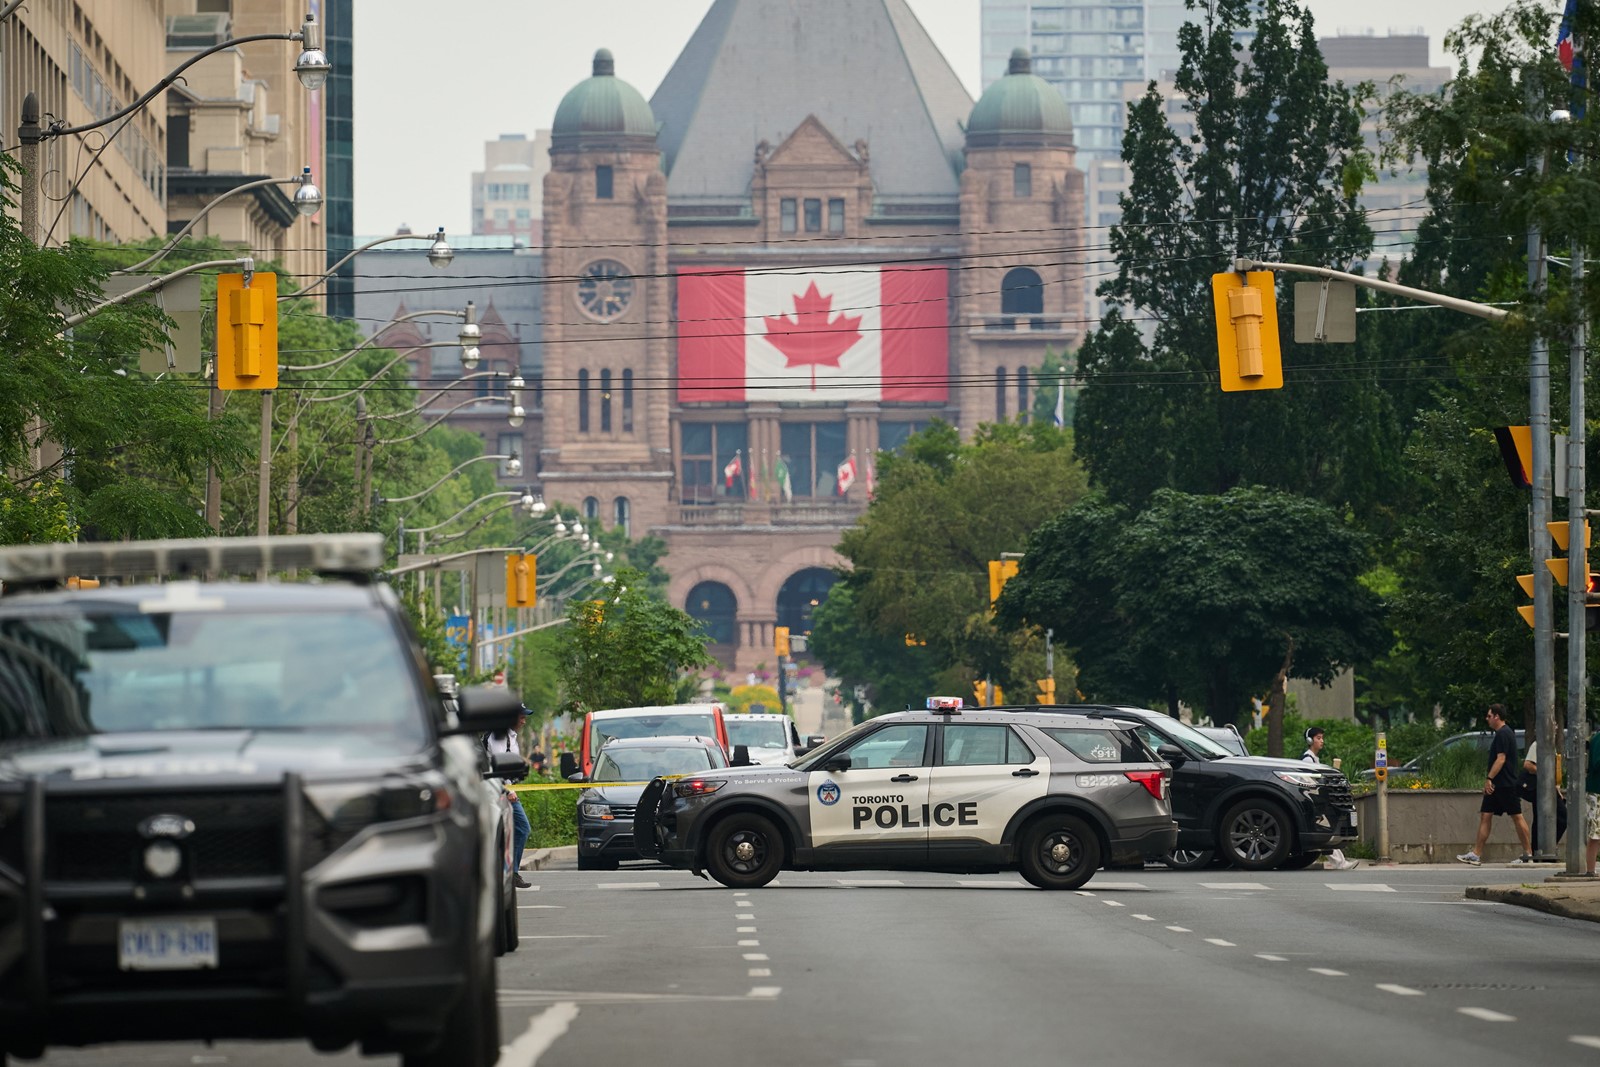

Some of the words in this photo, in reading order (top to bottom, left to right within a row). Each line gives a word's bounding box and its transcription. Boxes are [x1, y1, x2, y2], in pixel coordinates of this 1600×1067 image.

[1080, 775, 1119, 787] 5222
[852, 795, 904, 804] TORONTO
[852, 802, 979, 830] POLICE
